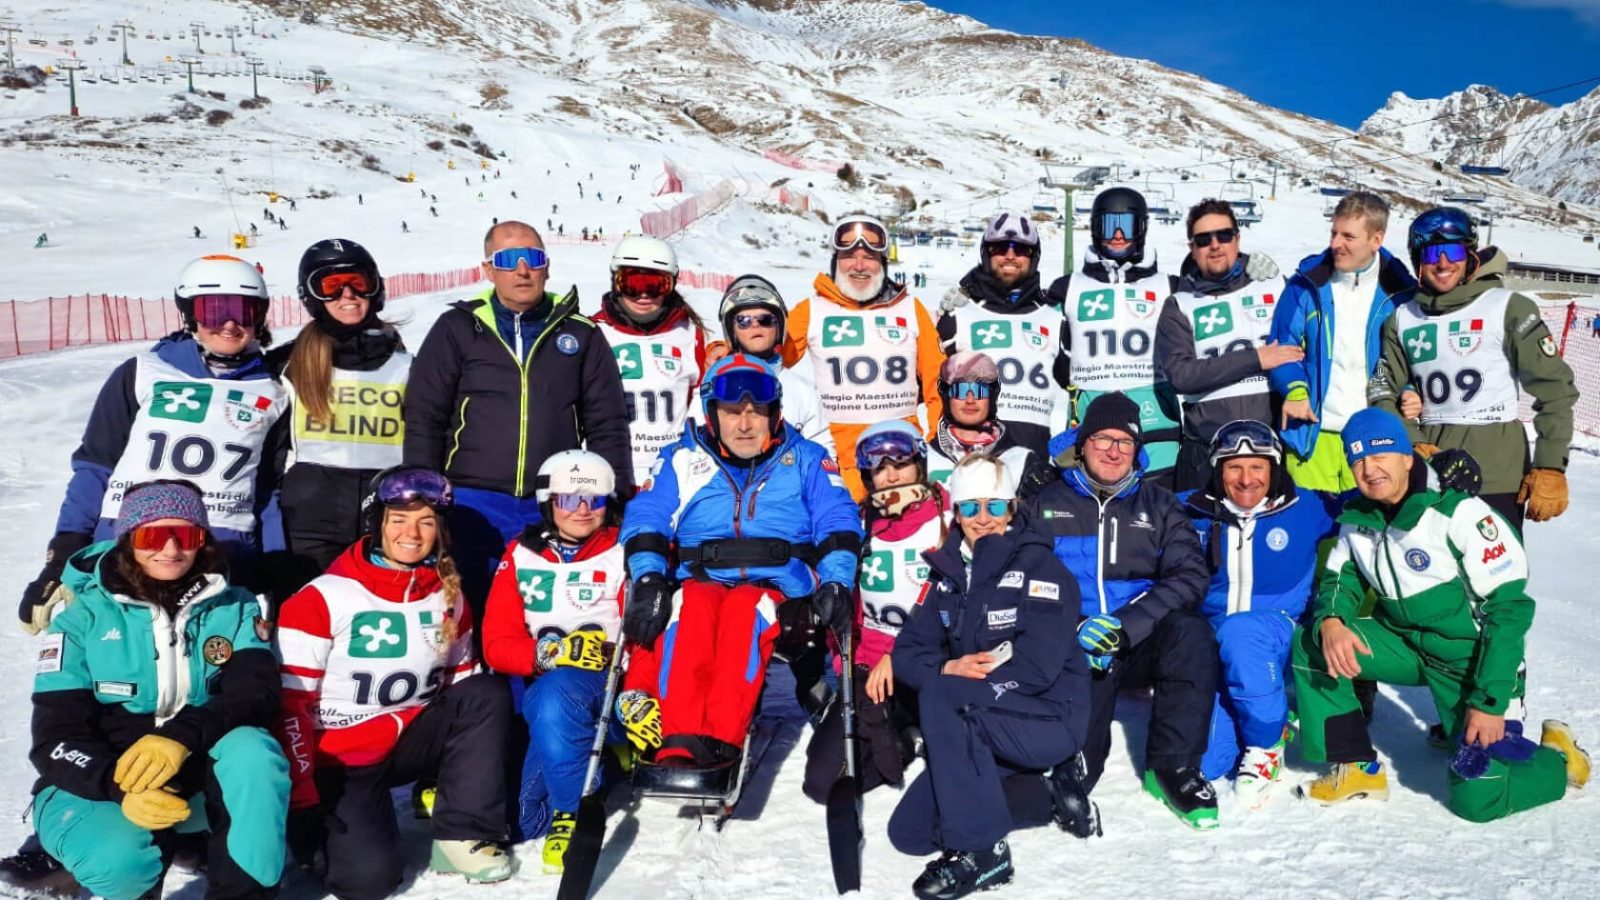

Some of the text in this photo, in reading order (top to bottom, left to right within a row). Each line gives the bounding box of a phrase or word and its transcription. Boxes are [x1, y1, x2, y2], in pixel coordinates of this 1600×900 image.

[1084, 329, 1150, 357] 110
[826, 355, 908, 385] 108
[996, 357, 1050, 390] 06
[1104, 363, 1145, 371] Maestri
[1000, 391, 1041, 404] Maestri
[304, 412, 400, 438] BLIND
[635, 432, 677, 441] Maestri
[147, 431, 252, 480] 107
[284, 716, 310, 773] ITALIA
